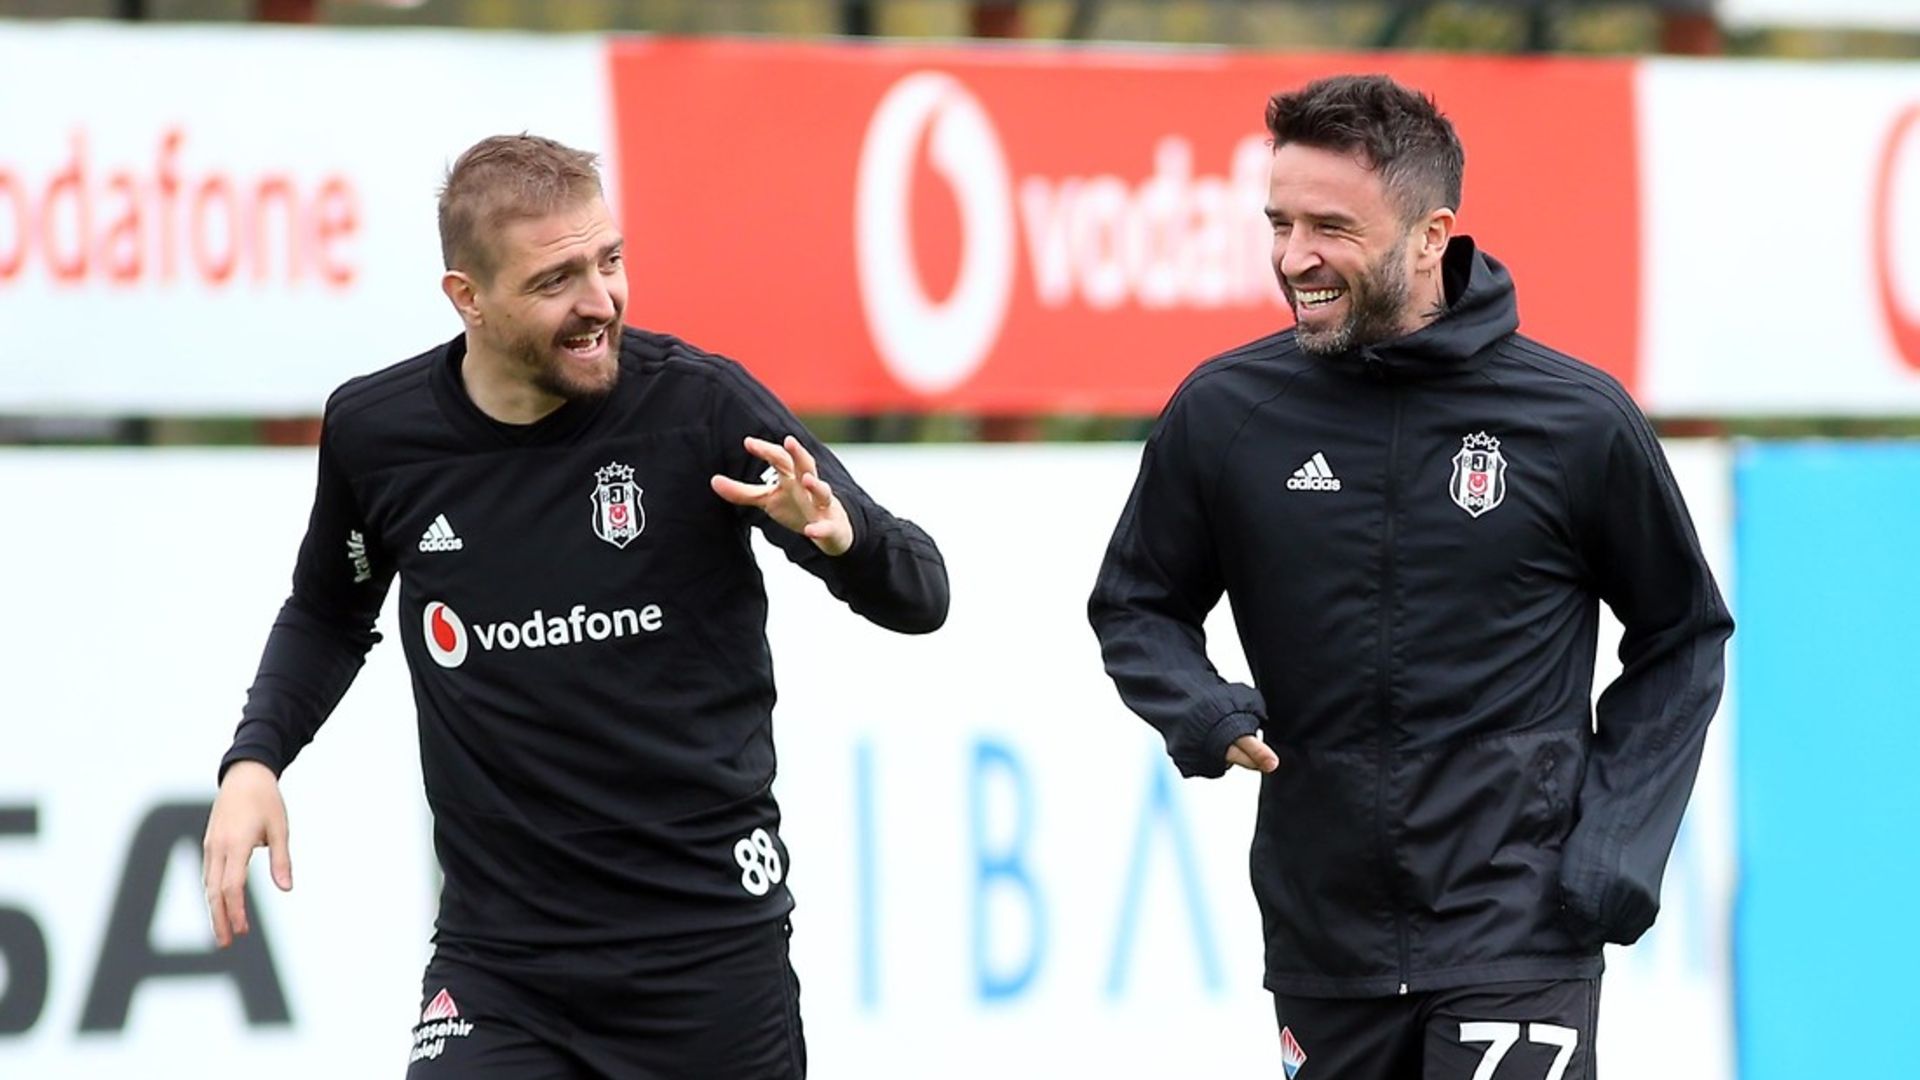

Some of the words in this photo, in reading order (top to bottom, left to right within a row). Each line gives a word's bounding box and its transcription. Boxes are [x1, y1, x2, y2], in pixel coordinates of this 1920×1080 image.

[1018, 134, 1290, 306] vodaf
[1286, 474, 1341, 491] adidas
[419, 537, 463, 552] adidas
[473, 603, 663, 651] vodafone
[734, 828, 782, 896] 88
[1459, 1021, 1578, 1080] 77
